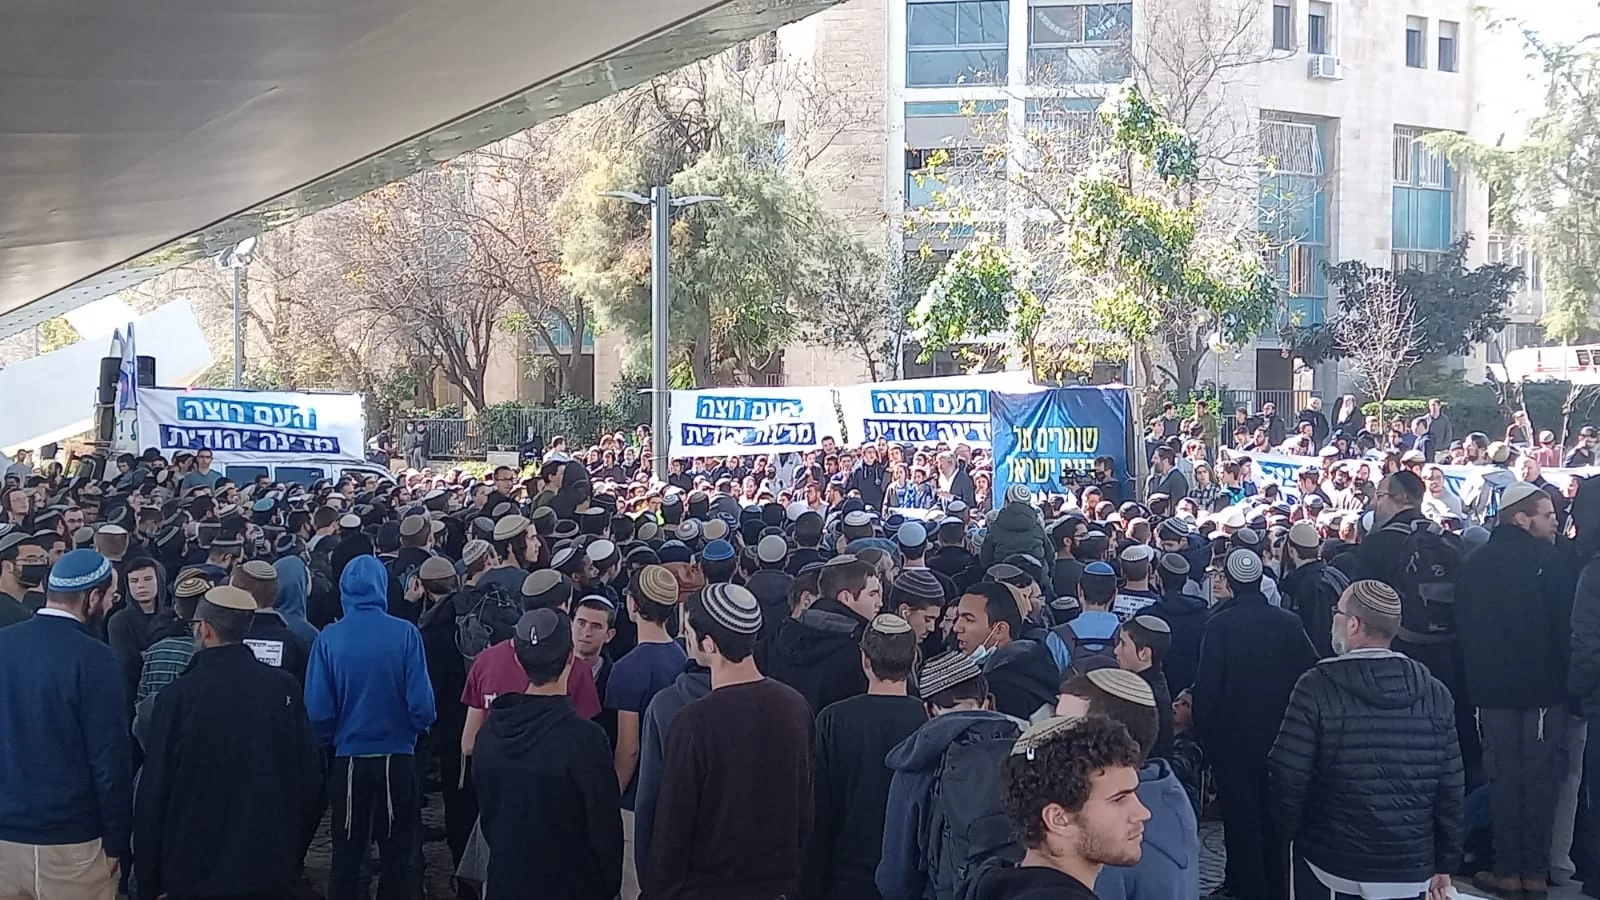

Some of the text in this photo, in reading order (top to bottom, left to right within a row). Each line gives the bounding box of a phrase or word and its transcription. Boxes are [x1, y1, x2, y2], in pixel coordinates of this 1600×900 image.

[185, 399, 315, 429] העם רוצה
[701, 398, 746, 419] רוצה
[932, 391, 982, 414] העם
[167, 426, 334, 453] מדינה יהודית
[867, 420, 991, 442] דינה יהודית
[1036, 427, 1099, 453] שומרים
[1006, 455, 1056, 484] ישראל
